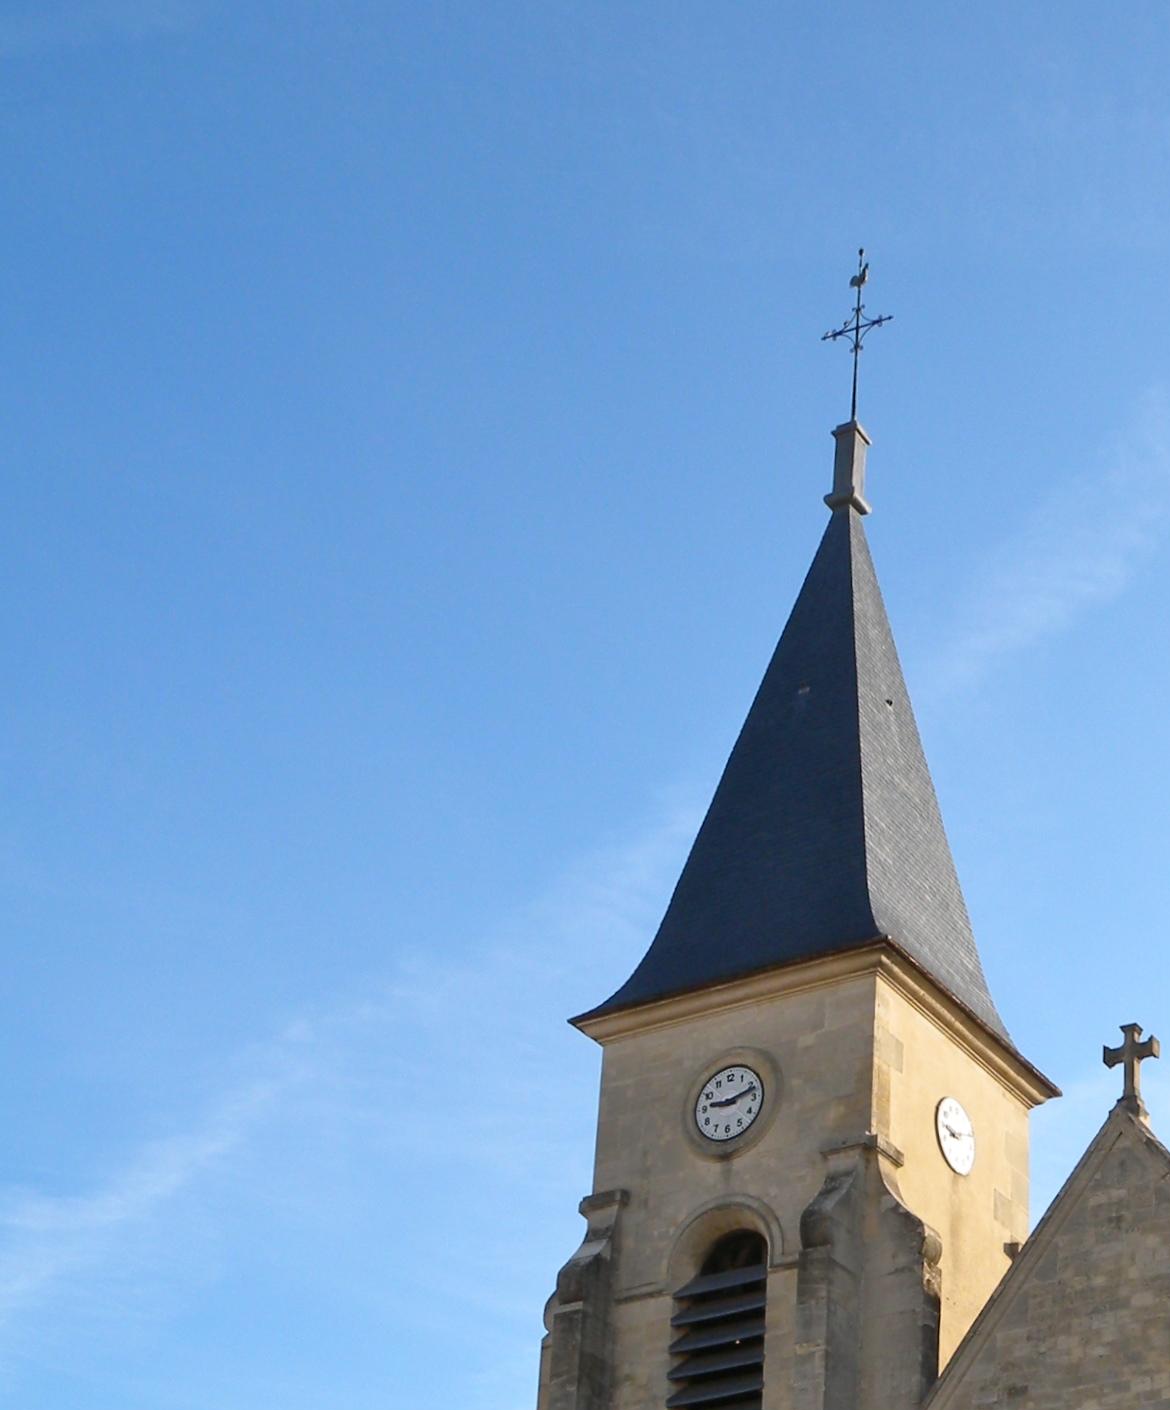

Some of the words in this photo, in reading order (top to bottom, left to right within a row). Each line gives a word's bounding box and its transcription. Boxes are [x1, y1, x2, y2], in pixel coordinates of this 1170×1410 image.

[726, 1073, 735, 1082] 12
[715, 1080, 722, 1088] 11
[705, 1092, 714, 1100] 10
[751, 1093, 757, 1101] 3
[702, 1105, 708, 1114] 9
[746, 1106, 752, 1114] 4
[704, 1117, 710, 1126] 8
[737, 1118, 743, 1127] 5
[713, 1124, 719, 1133] 7
[724, 1124, 731, 1133] 6
